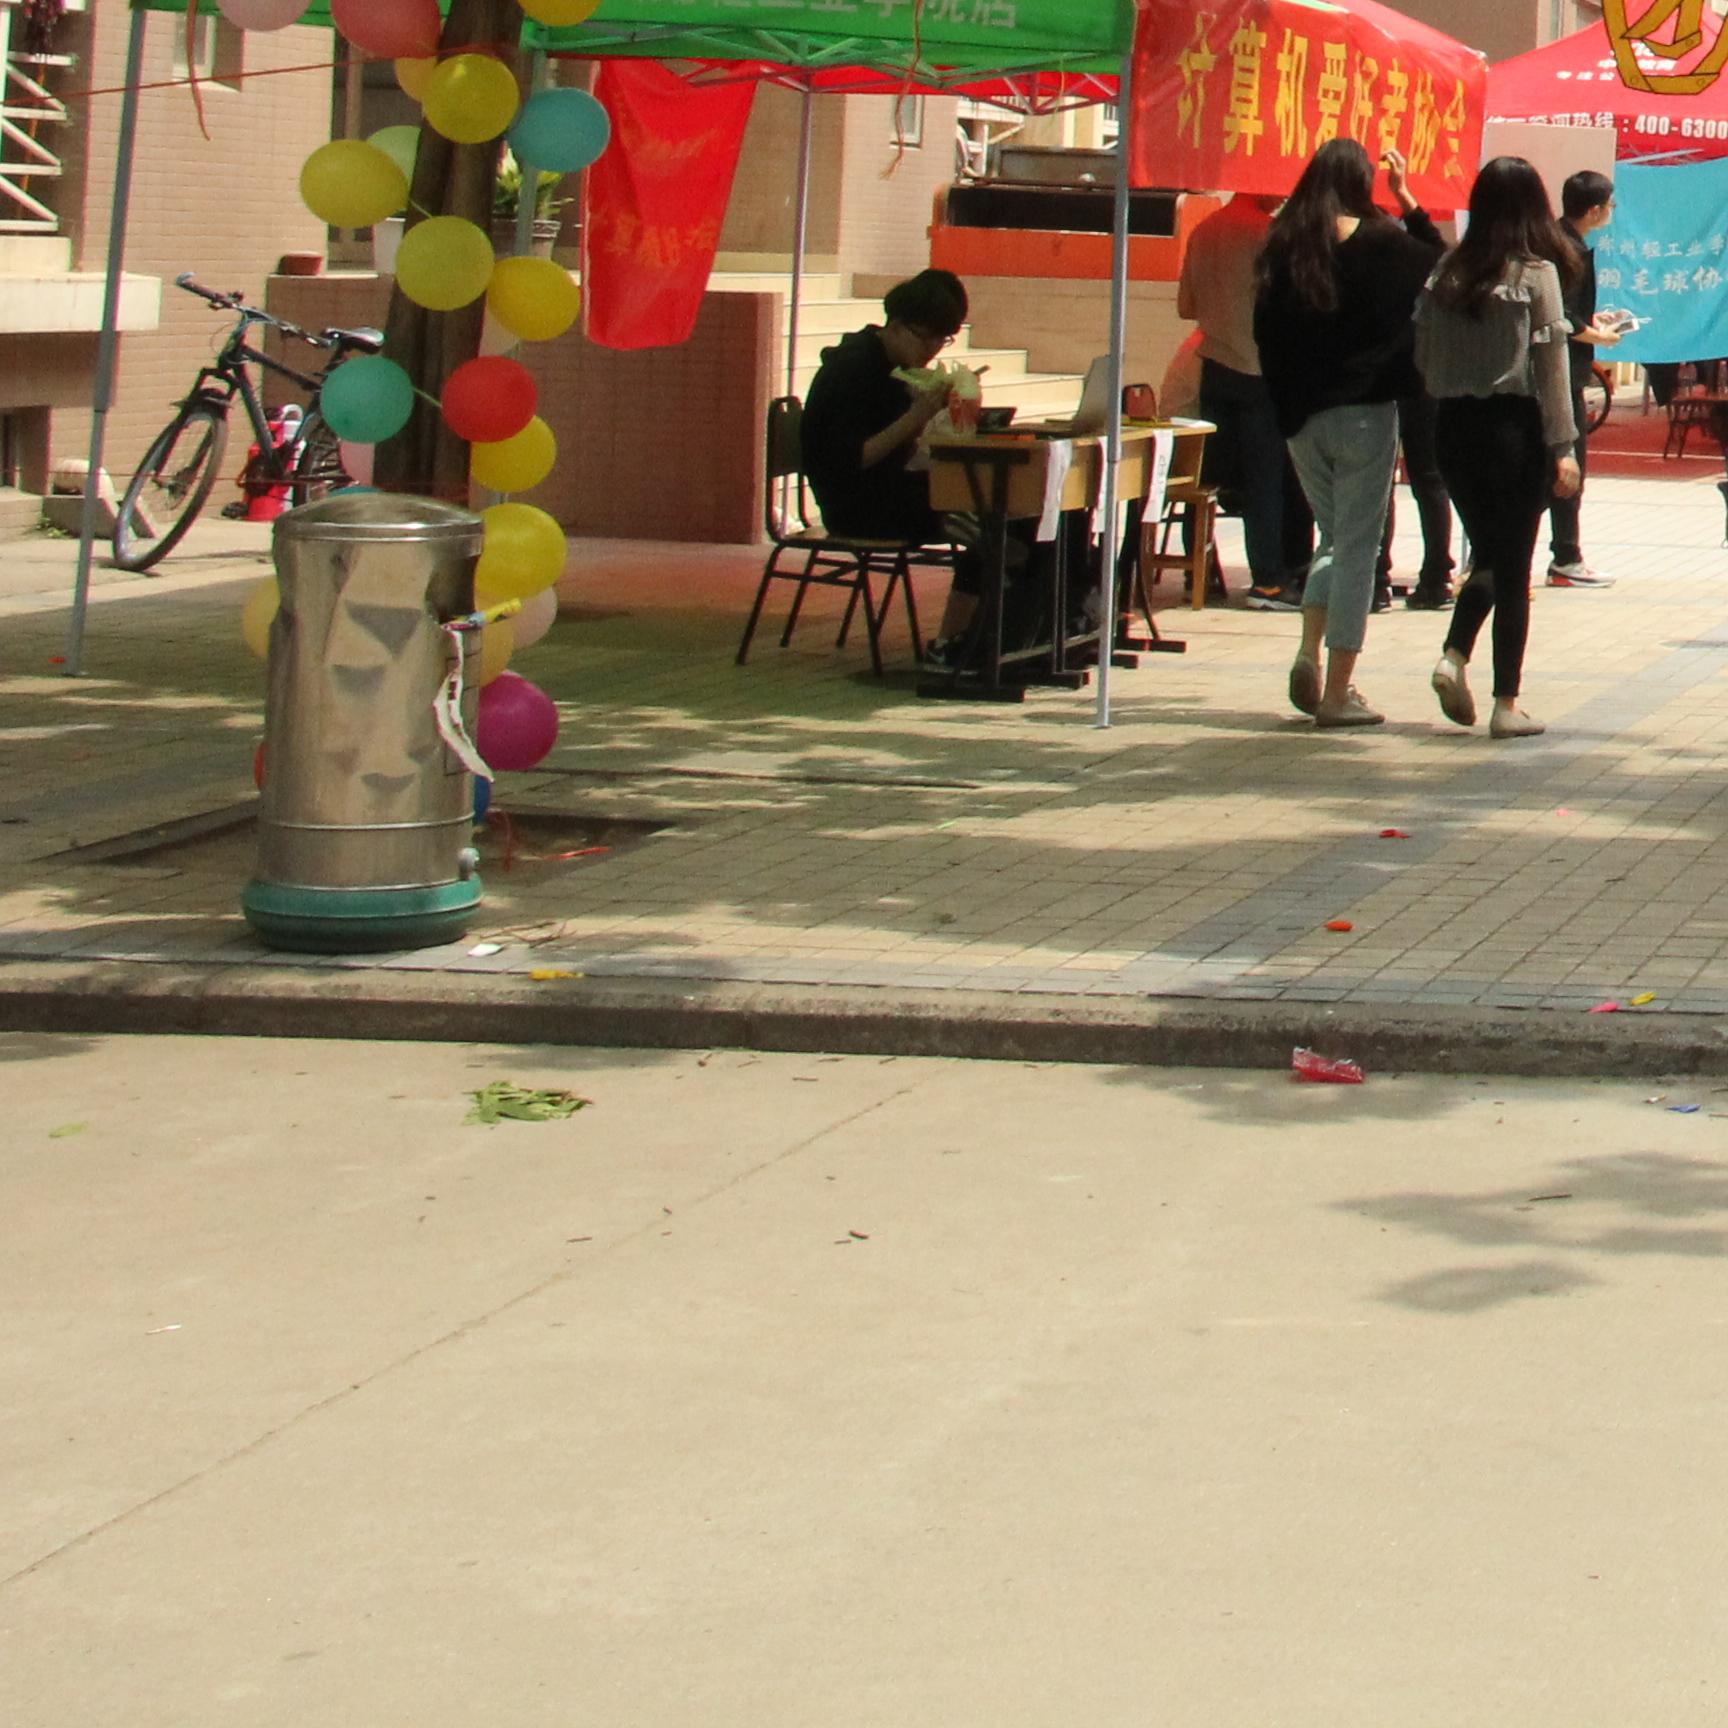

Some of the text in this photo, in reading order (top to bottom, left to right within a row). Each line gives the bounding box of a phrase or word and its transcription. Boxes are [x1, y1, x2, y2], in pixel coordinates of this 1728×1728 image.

[1176, 10, 1468, 180] 计算机爱好者协会
